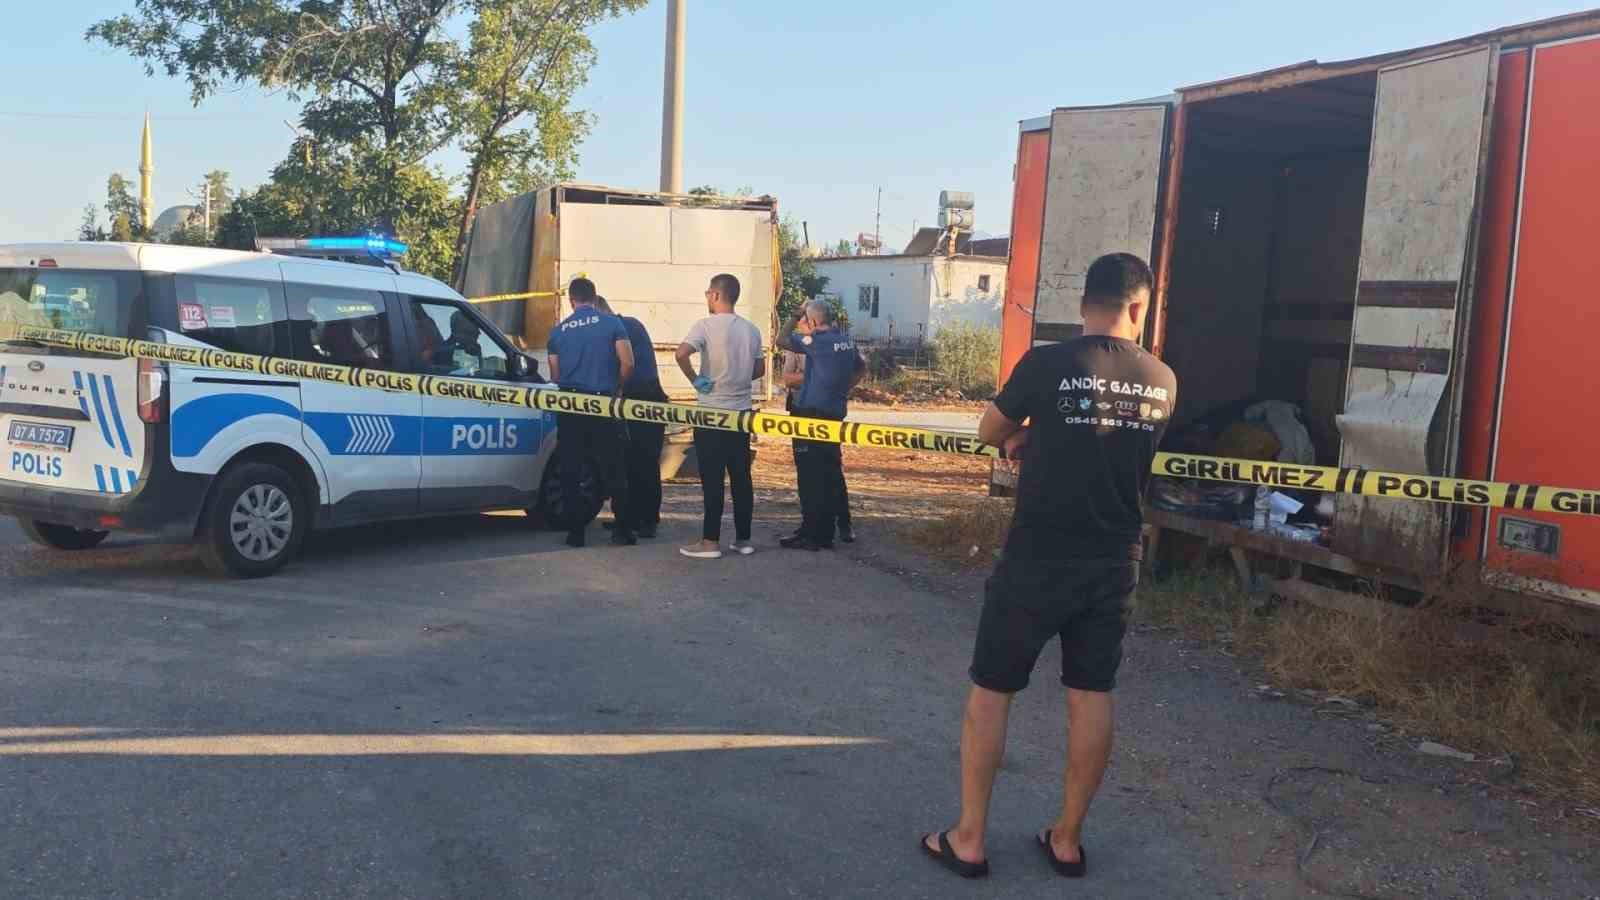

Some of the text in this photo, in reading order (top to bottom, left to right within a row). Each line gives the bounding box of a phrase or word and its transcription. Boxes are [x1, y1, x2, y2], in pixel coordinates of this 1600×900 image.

[183, 307, 202, 320] 112
[1110, 381, 1168, 401] GARAGE
[15, 426, 65, 443] 07 A 7572
